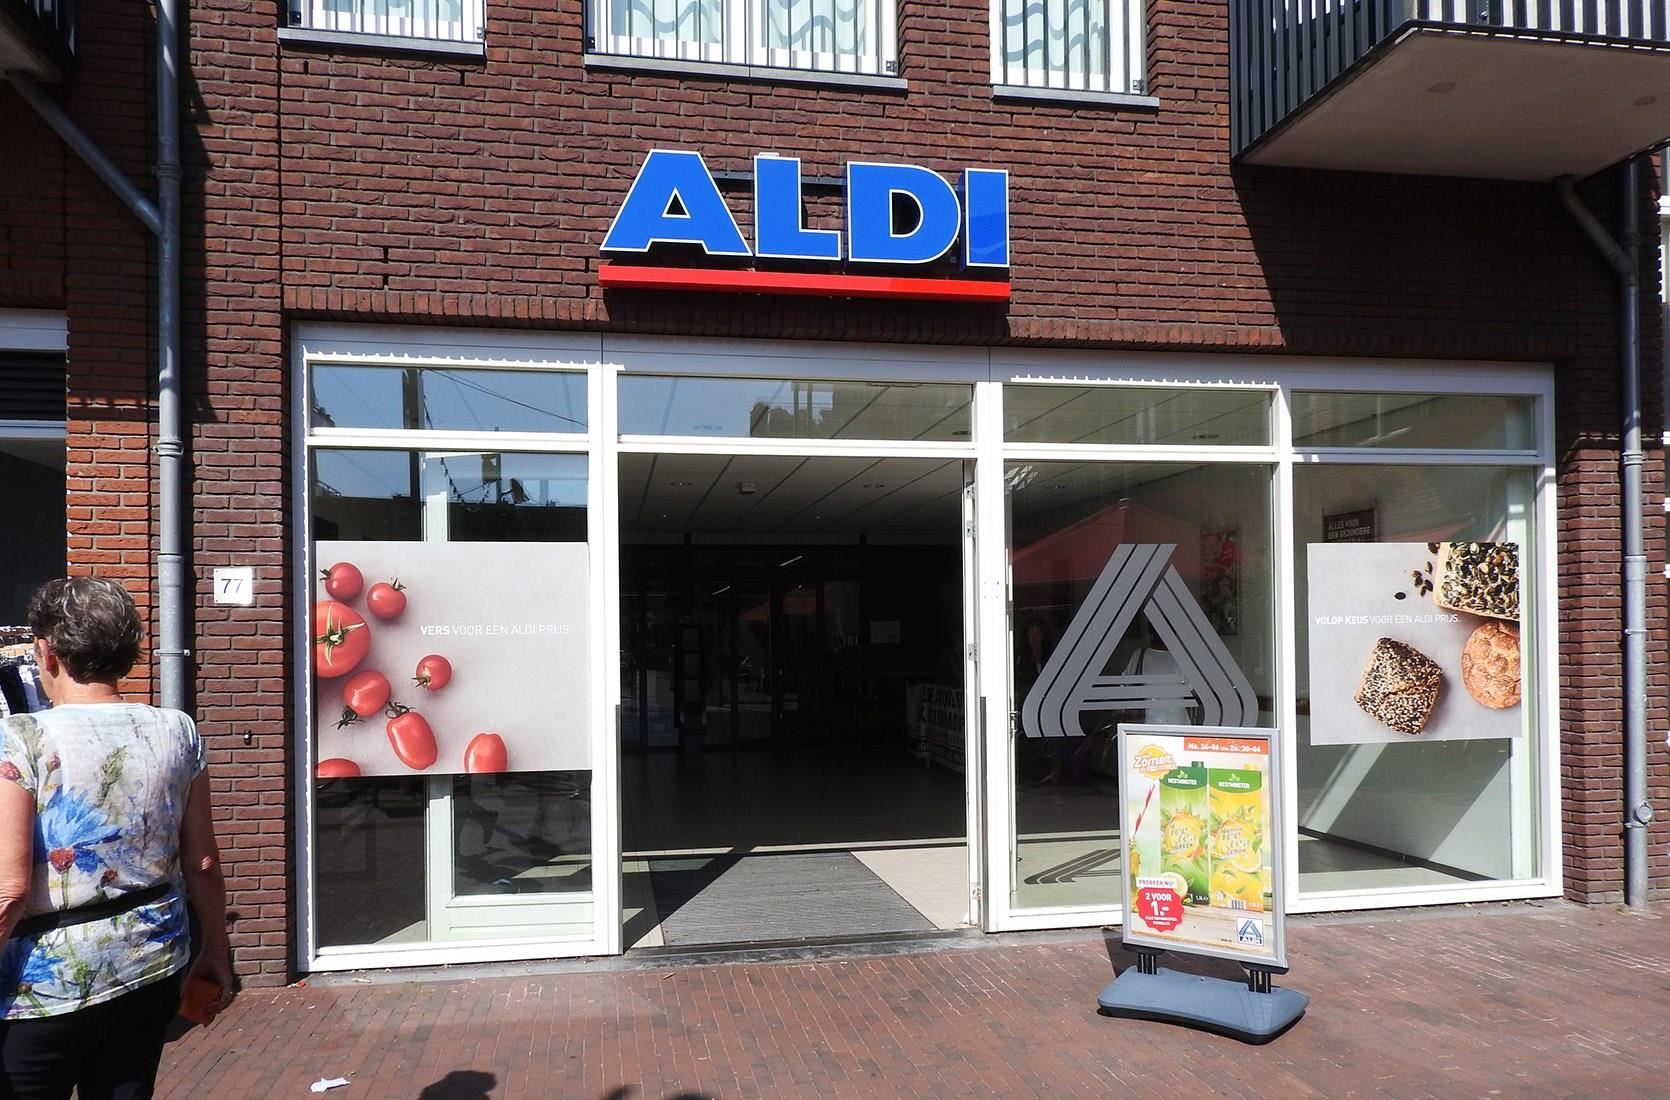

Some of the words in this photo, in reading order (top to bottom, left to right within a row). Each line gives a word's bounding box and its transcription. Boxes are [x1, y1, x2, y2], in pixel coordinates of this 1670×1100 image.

[600, 148, 1010, 268] ALDI
[220, 578, 244, 594] 77
[1315, 616, 1343, 625] VOLOP
[1345, 615, 1369, 625] KEUS
[1370, 615, 1393, 624] VOOR
[1395, 615, 1413, 624] EEN
[1414, 614, 1433, 624] ALDI
[420, 625, 450, 636] VERS
[452, 624, 483, 636] VOOR
[486, 624, 508, 635] EEN
[511, 624, 536, 635] ALDI
[1145, 892, 1151, 900] 2
[1151, 892, 1173, 902] VOOR
